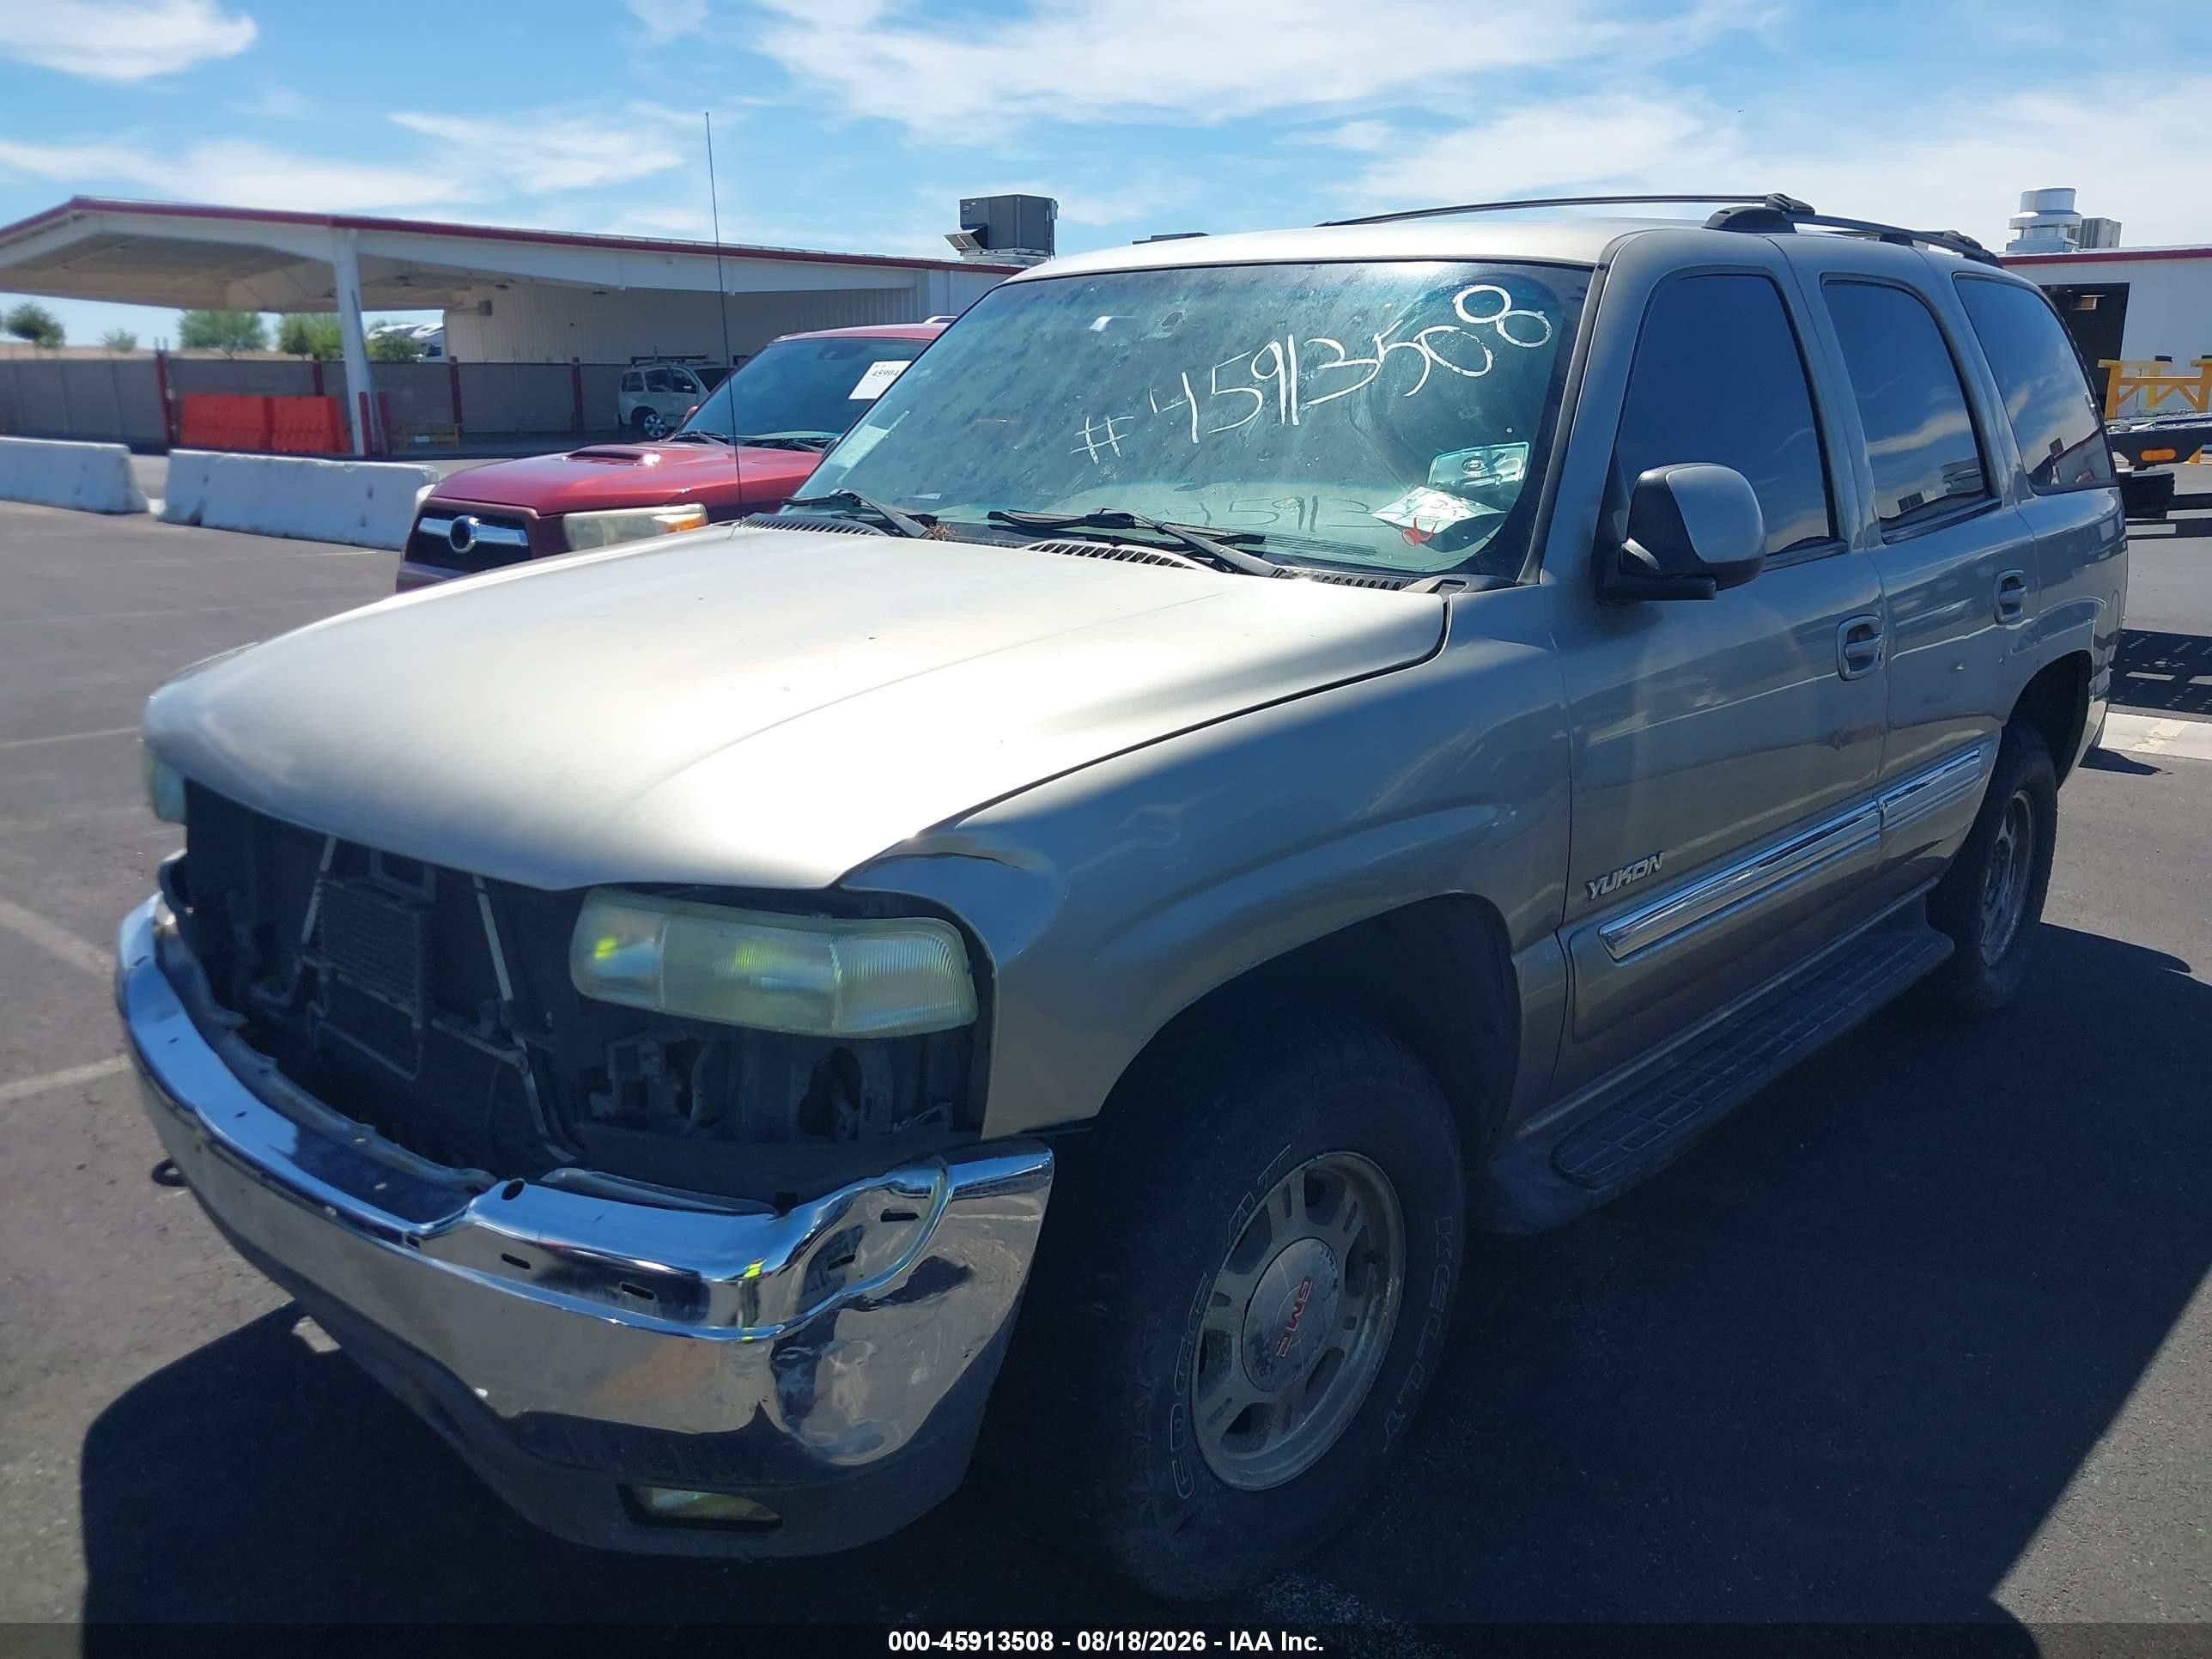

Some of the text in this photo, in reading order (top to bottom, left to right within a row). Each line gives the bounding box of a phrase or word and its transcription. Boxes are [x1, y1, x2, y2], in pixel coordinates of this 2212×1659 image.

[1587, 852, 1665, 900] YUKON
[1170, 1271, 1209, 1498] EDGE
[1276, 1275, 1314, 1358] GMC
[1382, 1215, 1453, 1454] KELLY
